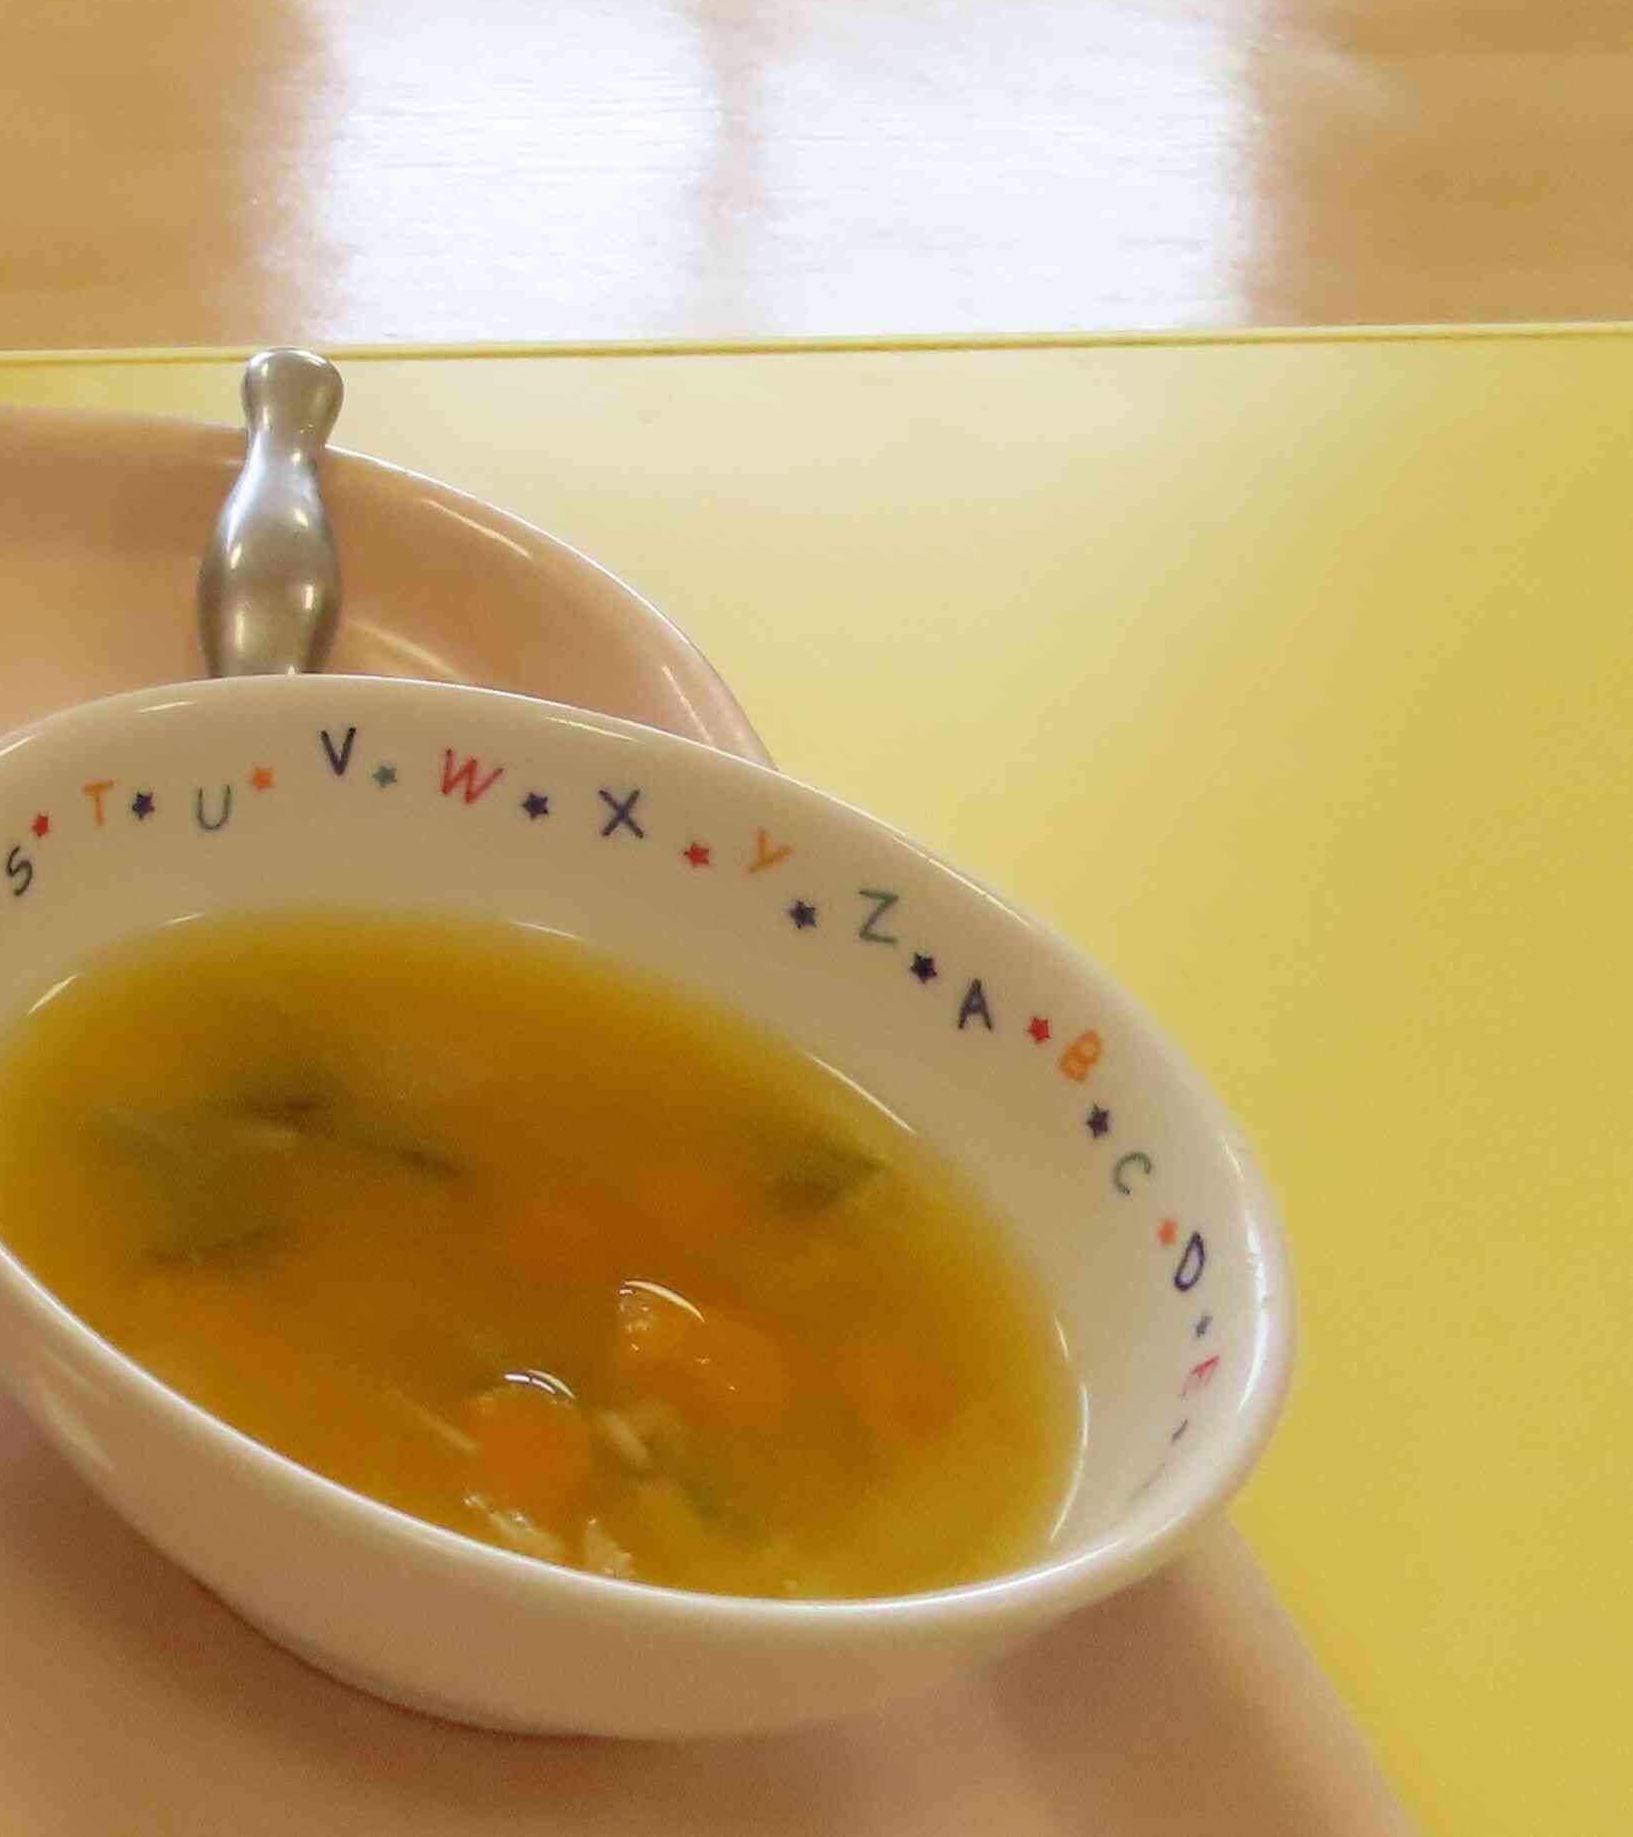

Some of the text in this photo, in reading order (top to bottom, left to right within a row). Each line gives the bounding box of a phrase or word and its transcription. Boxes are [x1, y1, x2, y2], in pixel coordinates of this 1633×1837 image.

[6, 846, 33, 897] S
[82, 781, 114, 827] T
[197, 785, 232, 830] U
[320, 727, 356, 776] V
[441, 747, 505, 805] W
[597, 788, 645, 839] X
[742, 827, 794, 875] Y
[858, 888, 899, 945] Z
[958, 979, 993, 1031] A
[1058, 1029, 1103, 1082] B
[1113, 1151, 1153, 1196] C
[1174, 1231, 1206, 1292] D
